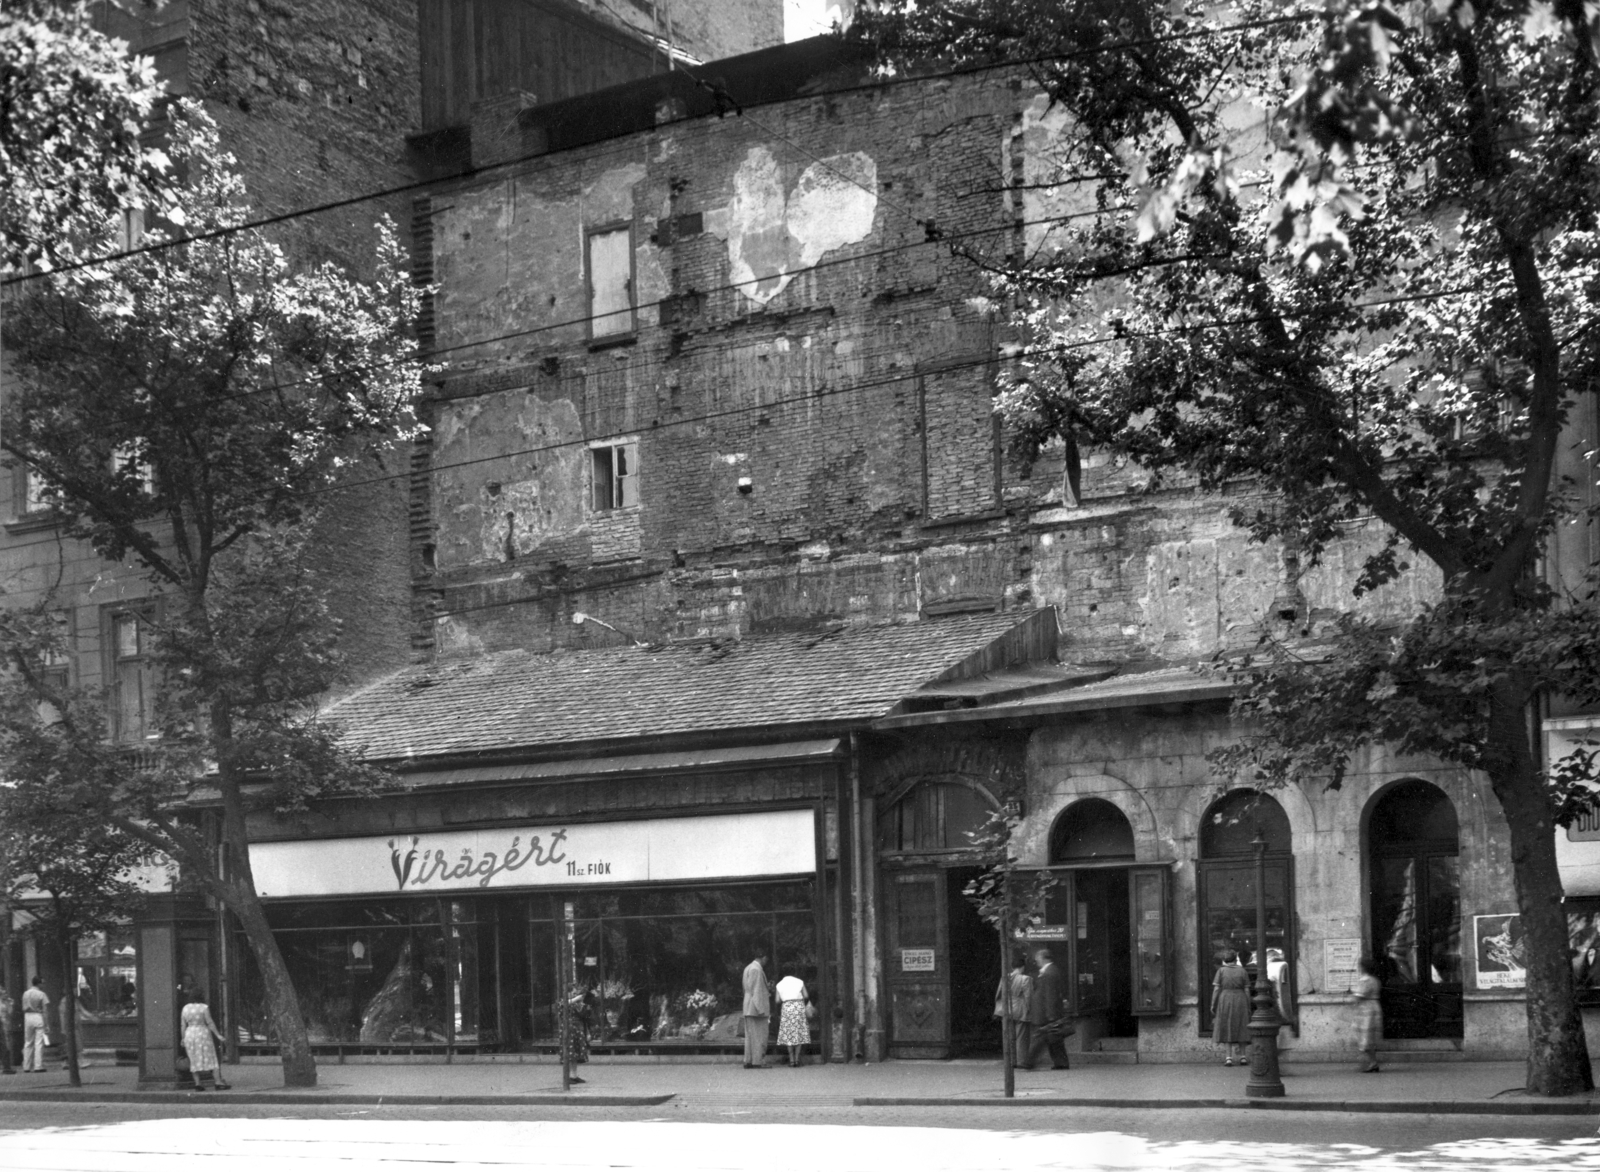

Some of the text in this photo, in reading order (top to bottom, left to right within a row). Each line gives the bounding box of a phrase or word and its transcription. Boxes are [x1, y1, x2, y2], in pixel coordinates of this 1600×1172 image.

[387, 829, 567, 890] Virágért
[588, 859, 611, 875] FIÓK
[904, 955, 933, 965] CIPÉSZ
